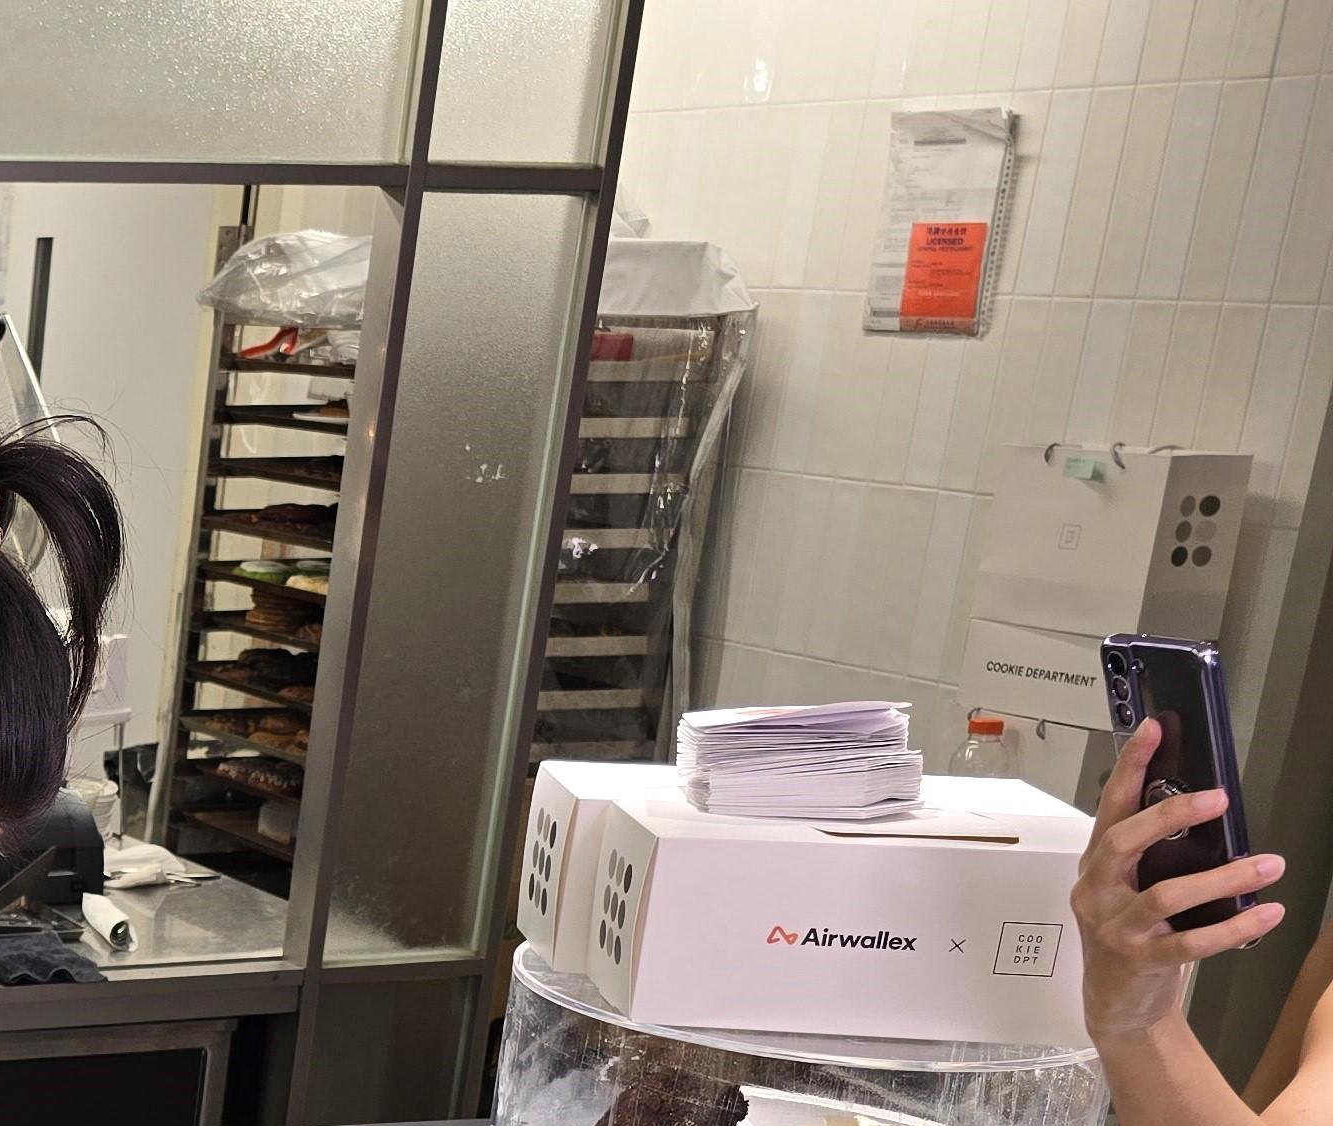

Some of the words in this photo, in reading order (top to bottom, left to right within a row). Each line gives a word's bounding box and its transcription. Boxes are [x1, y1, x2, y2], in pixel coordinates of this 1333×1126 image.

[986, 661, 1024, 677] COOKIE
[1025, 667, 1097, 687] DEPARTMENT
[801, 927, 917, 951] Airwallex
[1018, 934, 1043, 944] COO
[1015, 945, 1041, 954] KIE
[1013, 955, 1039, 965] DPT
